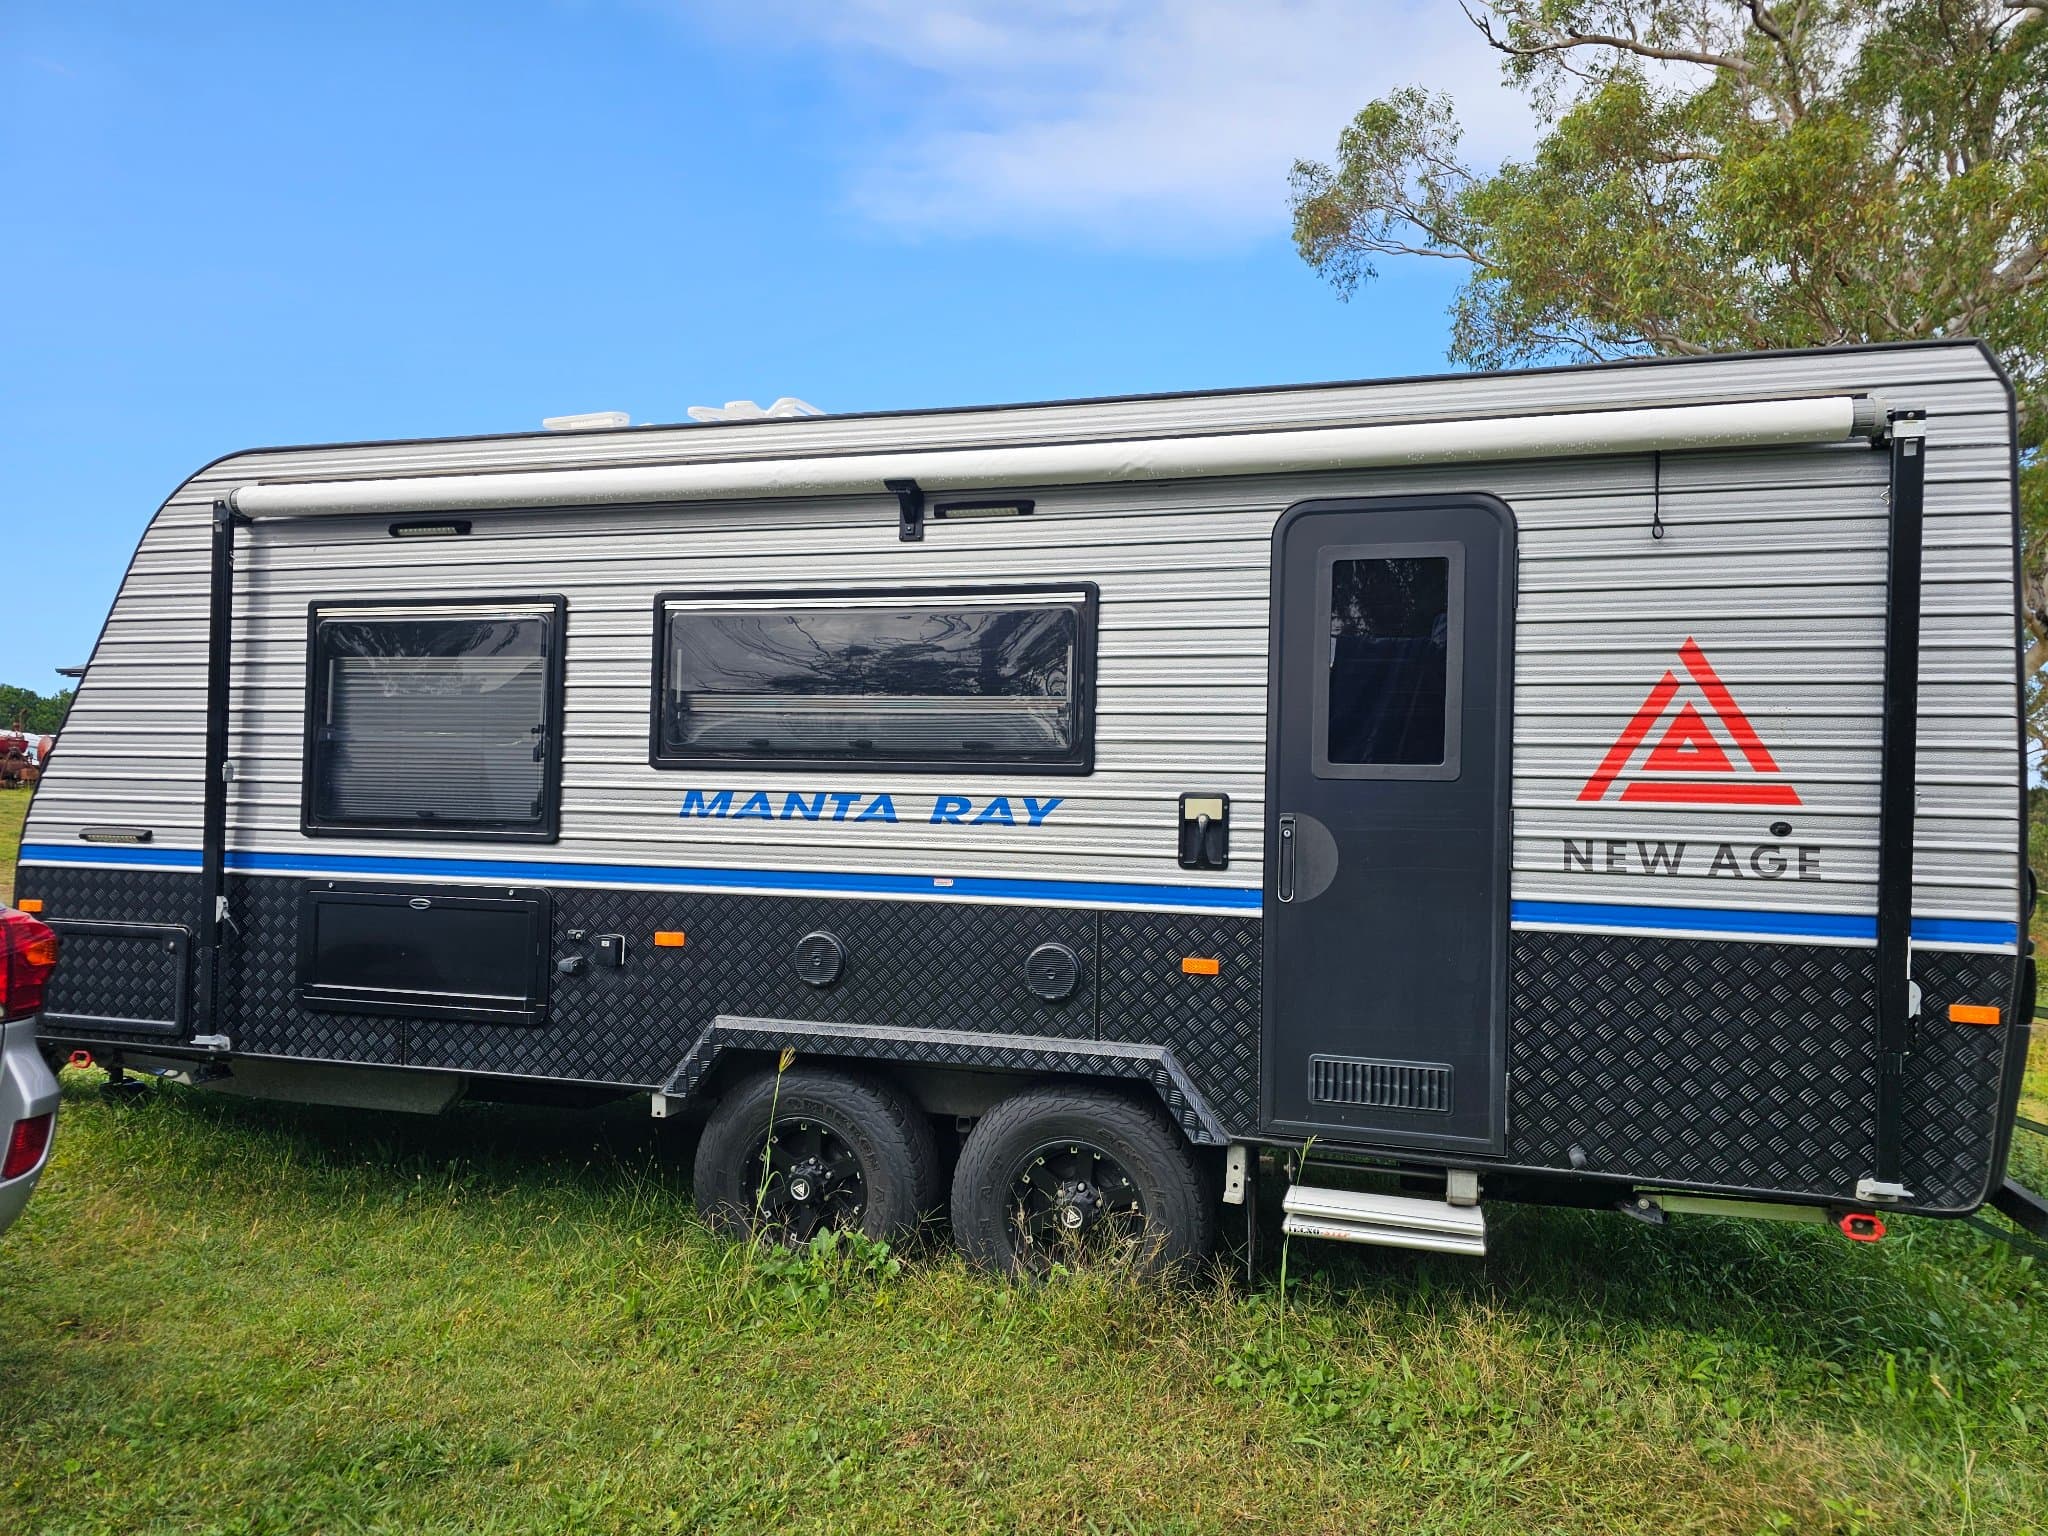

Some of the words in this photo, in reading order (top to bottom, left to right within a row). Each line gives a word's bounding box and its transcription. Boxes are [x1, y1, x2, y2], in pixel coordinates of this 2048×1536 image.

[679, 789, 901, 824] MANTA
[929, 795, 1065, 828] RAY
[1562, 838, 1687, 877] NEW
[1707, 842, 1822, 881] AGE
